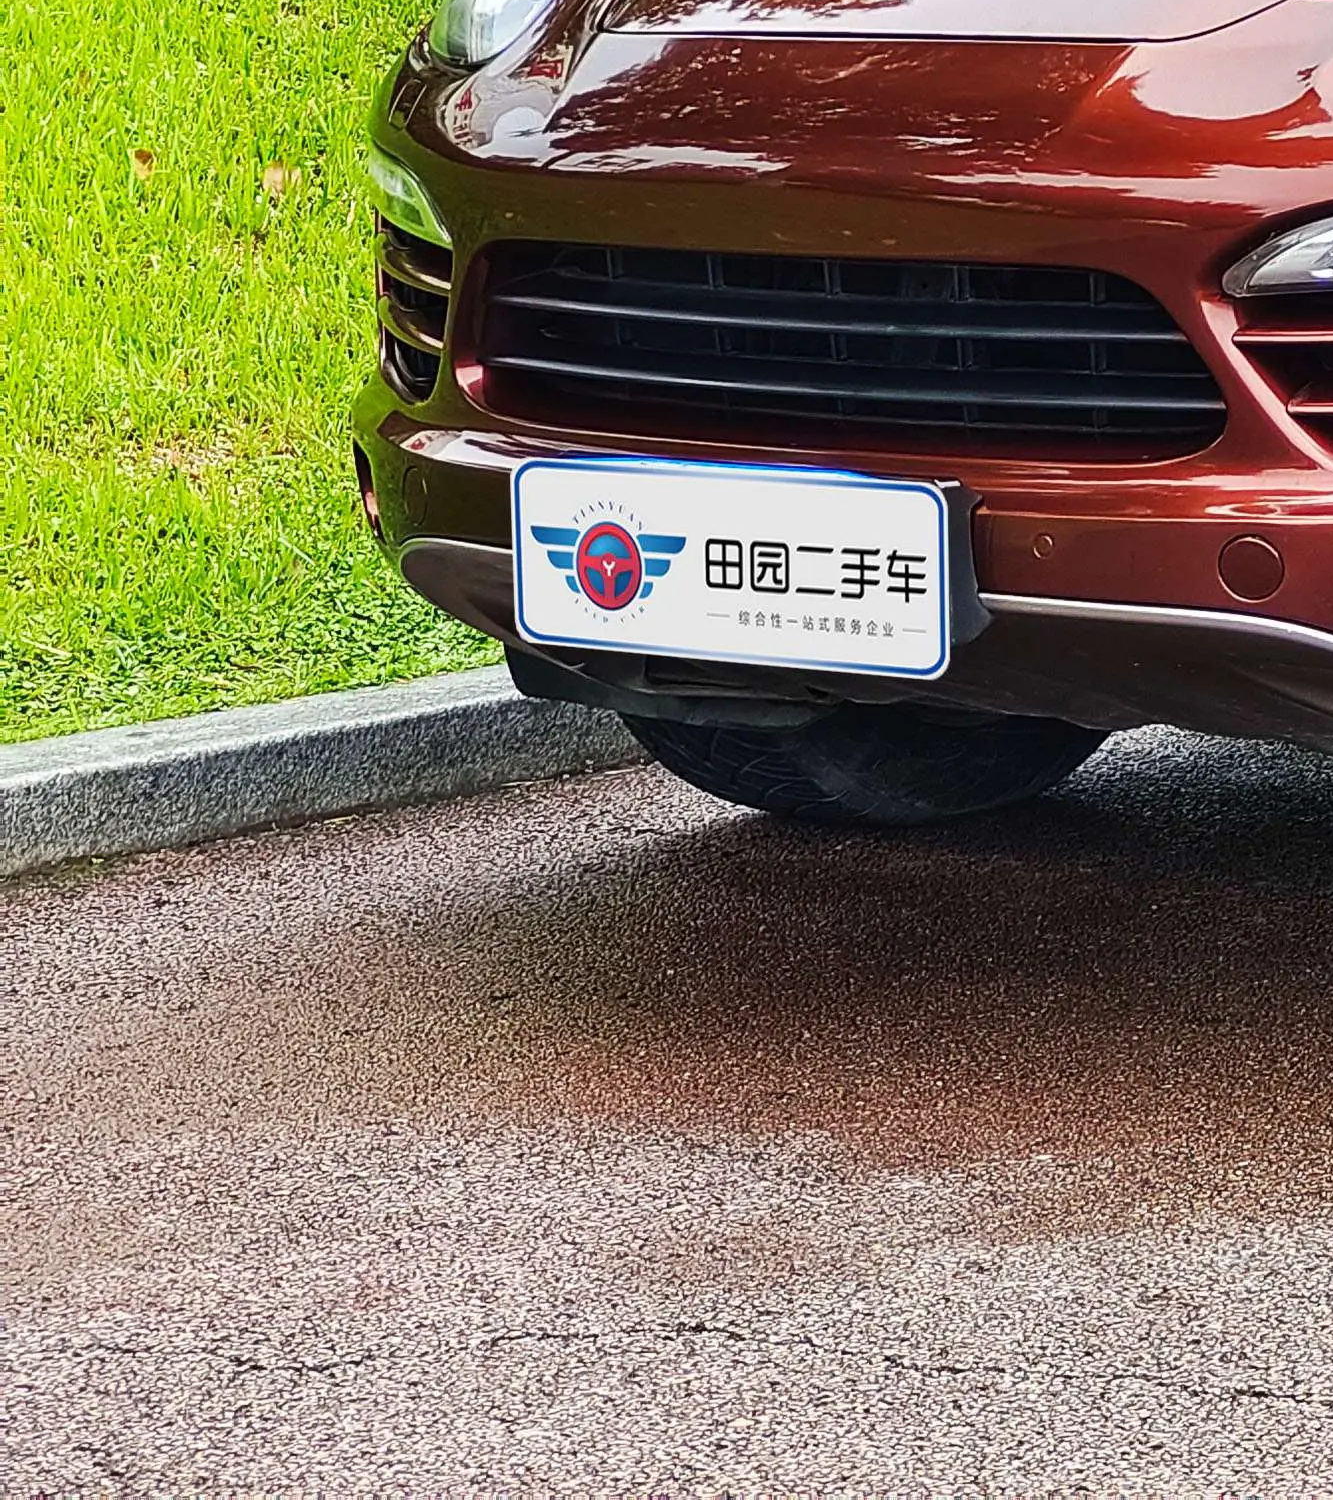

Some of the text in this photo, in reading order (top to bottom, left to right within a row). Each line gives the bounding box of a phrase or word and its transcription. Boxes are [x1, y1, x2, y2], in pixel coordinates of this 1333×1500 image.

[705, 538, 928, 603] 田园二手车
[738, 610, 895, 638] 综合性一站式服务企业
